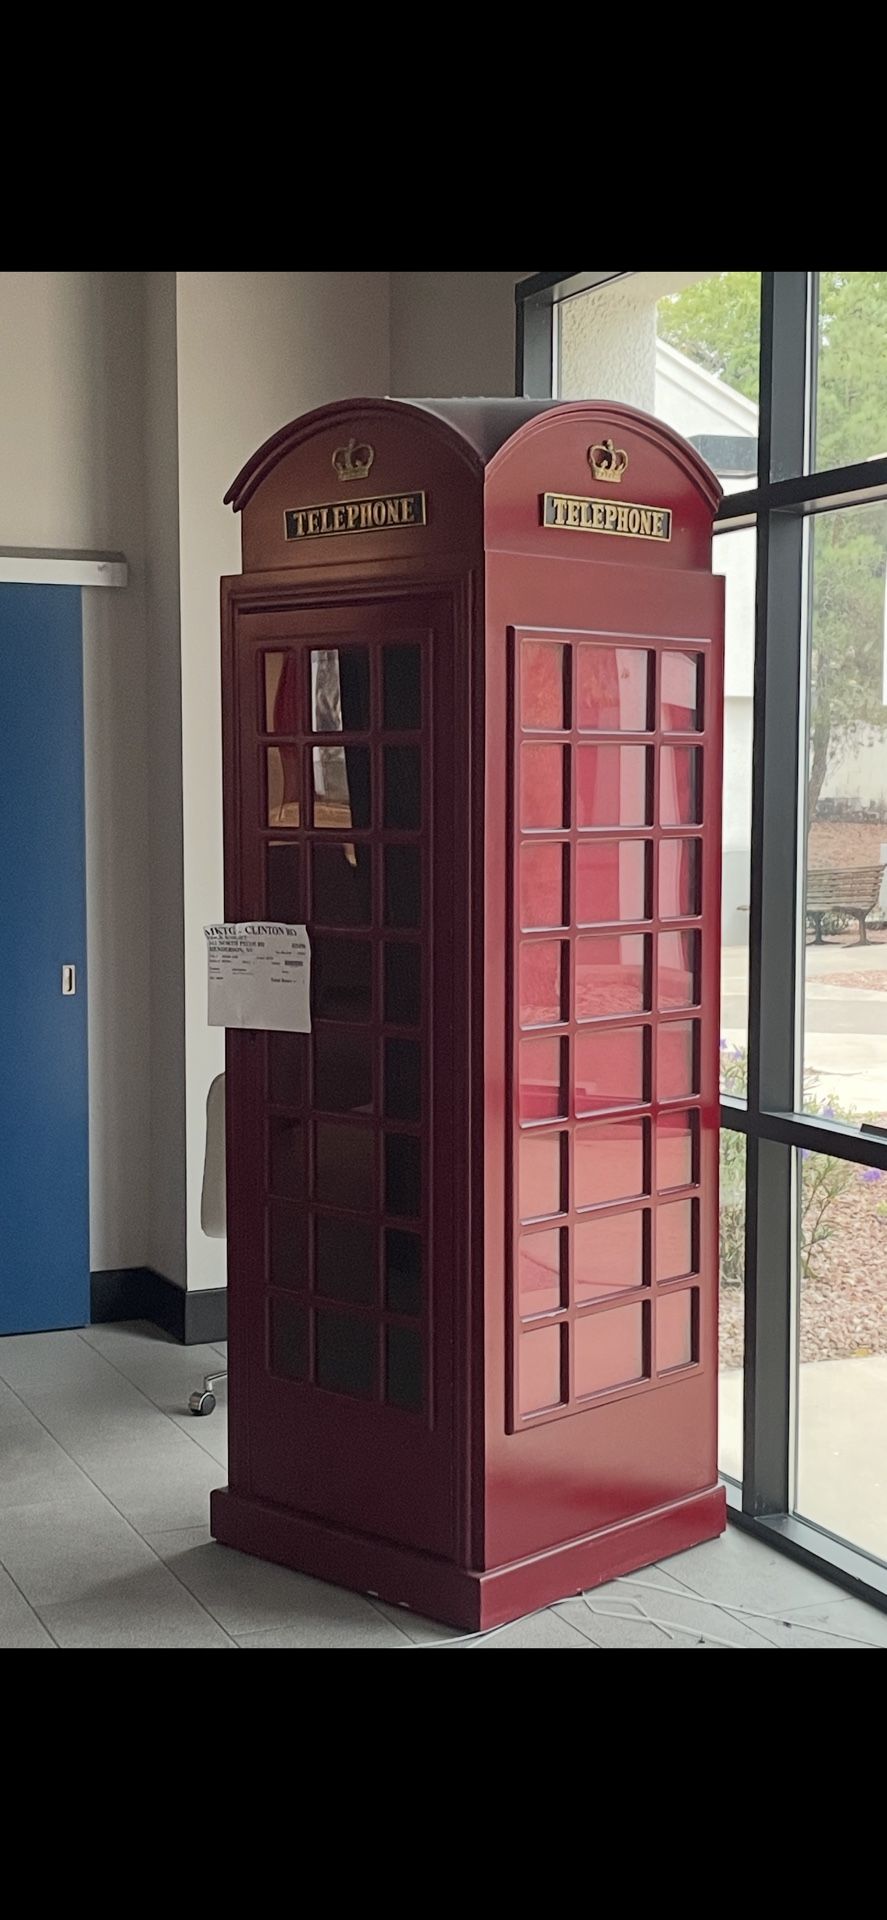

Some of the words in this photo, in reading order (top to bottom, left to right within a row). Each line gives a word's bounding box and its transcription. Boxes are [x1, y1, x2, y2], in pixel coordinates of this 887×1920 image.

[293, 496, 416, 537] TELEPHONE
[551, 497, 665, 537] TELEPHONE
[244, 925, 285, 936] CLINTON
